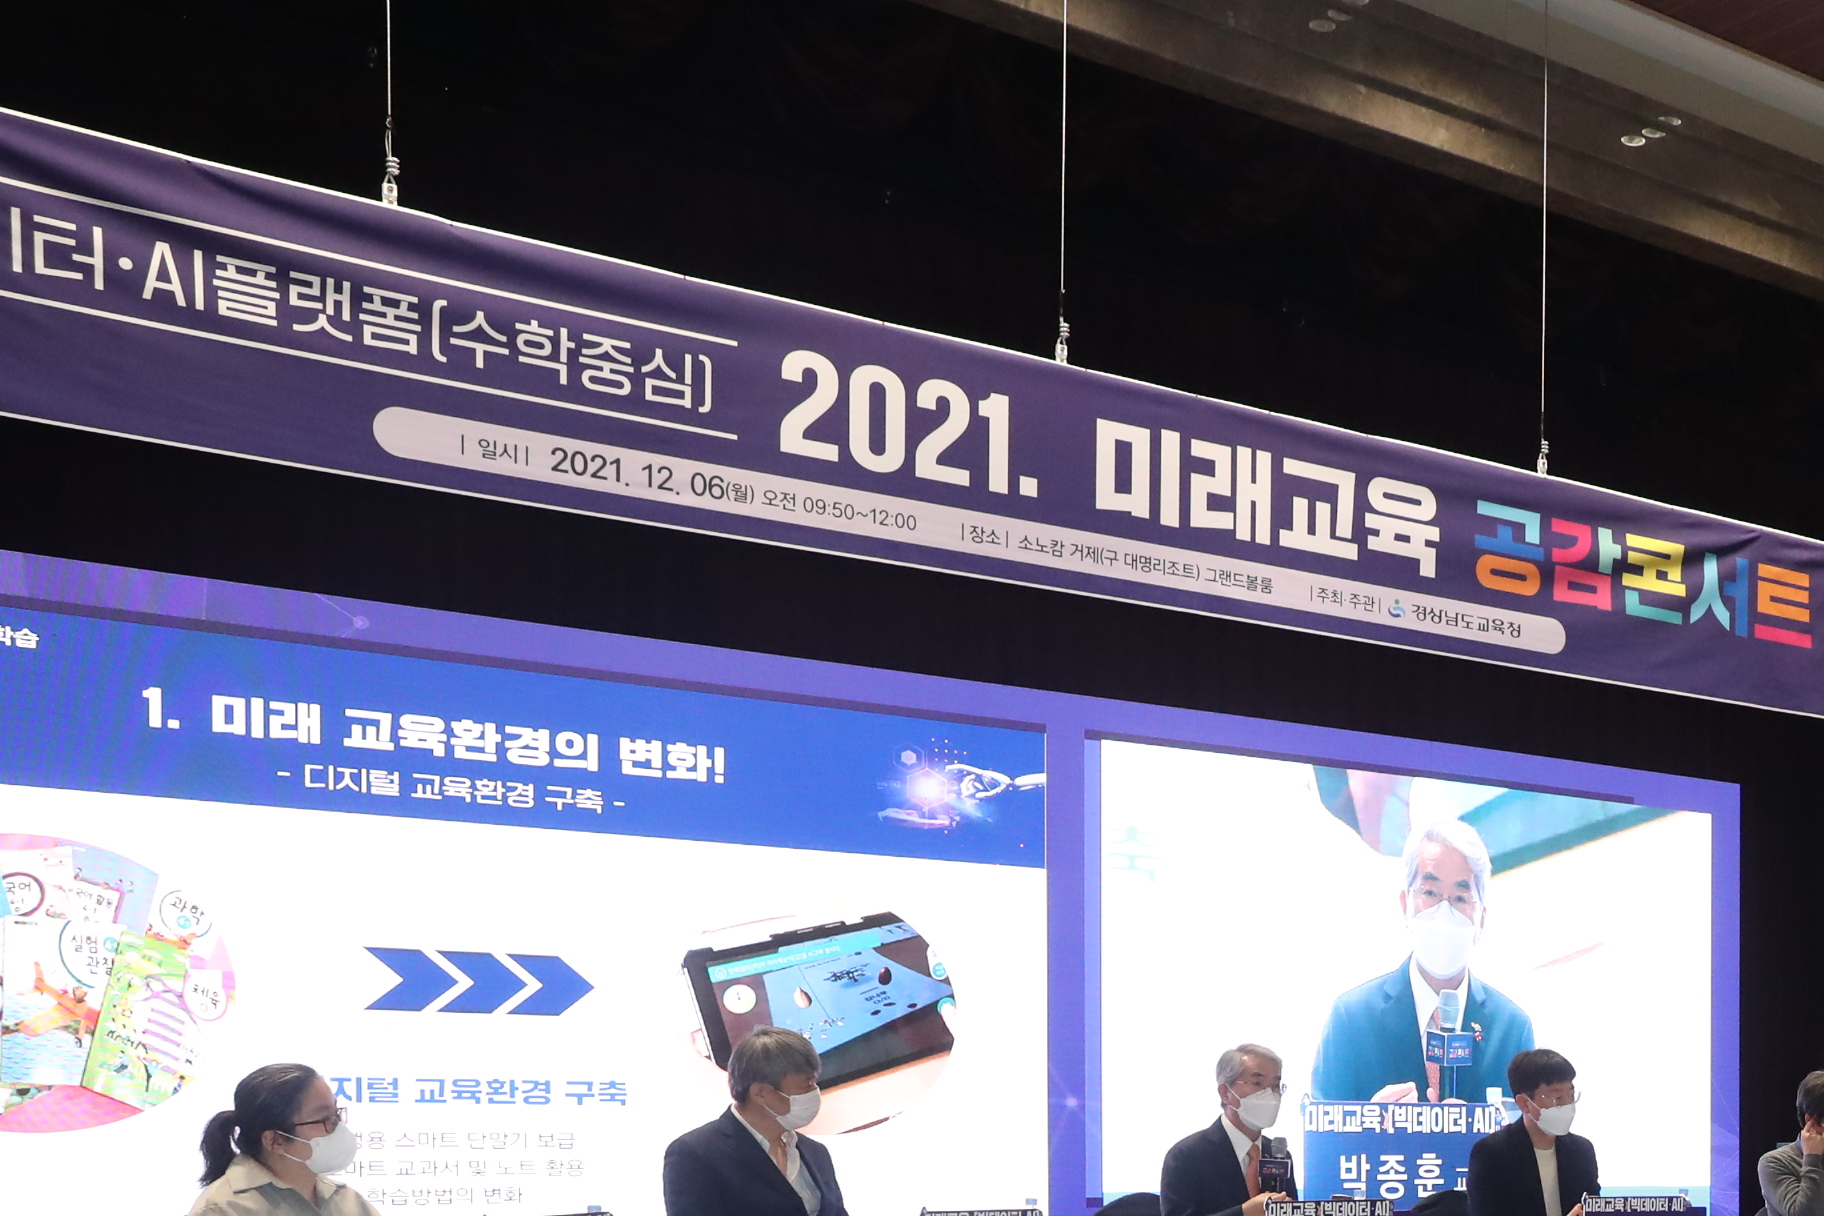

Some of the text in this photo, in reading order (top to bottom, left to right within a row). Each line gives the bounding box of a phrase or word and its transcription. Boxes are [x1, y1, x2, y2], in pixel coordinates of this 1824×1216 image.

[780, 350, 1039, 499] 2021.
[1096, 418, 1441, 578] 미래교육
[551, 447, 630, 486] 2021.
[641, 463, 681, 495] 12.
[761, 489, 797, 512] 오전
[803, 496, 917, 531] 09:50~12:00
[1018, 536, 1065, 558] 소노캄
[1204, 567, 1274, 594] 그랜드볼룸
[1411, 603, 1522, 639] 경상남도교육청
[142, 687, 727, 784] 1. 미래 교육환경의 변화!
[303, 765, 401, 798] 디지털
[410, 773, 536, 809] 교육환경
[545, 785, 604, 815] 구축
[330, 1077, 627, 1106] 지털 교육환경 구축
[1304, 1104, 1381, 1134] 미래교육
[395, 1132, 459, 1148] 스마트
[468, 1132, 527, 1150] 단말기
[537, 1132, 575, 1150] 보급
[396, 1161, 458, 1177] 교과서
[469, 1161, 486, 1176] 및
[497, 1160, 537, 1175] 노트
[546, 1160, 584, 1177] 활용
[367, 1187, 523, 1206] 학습방법의 변화
[1585, 1197, 1625, 1213] 미래교육
